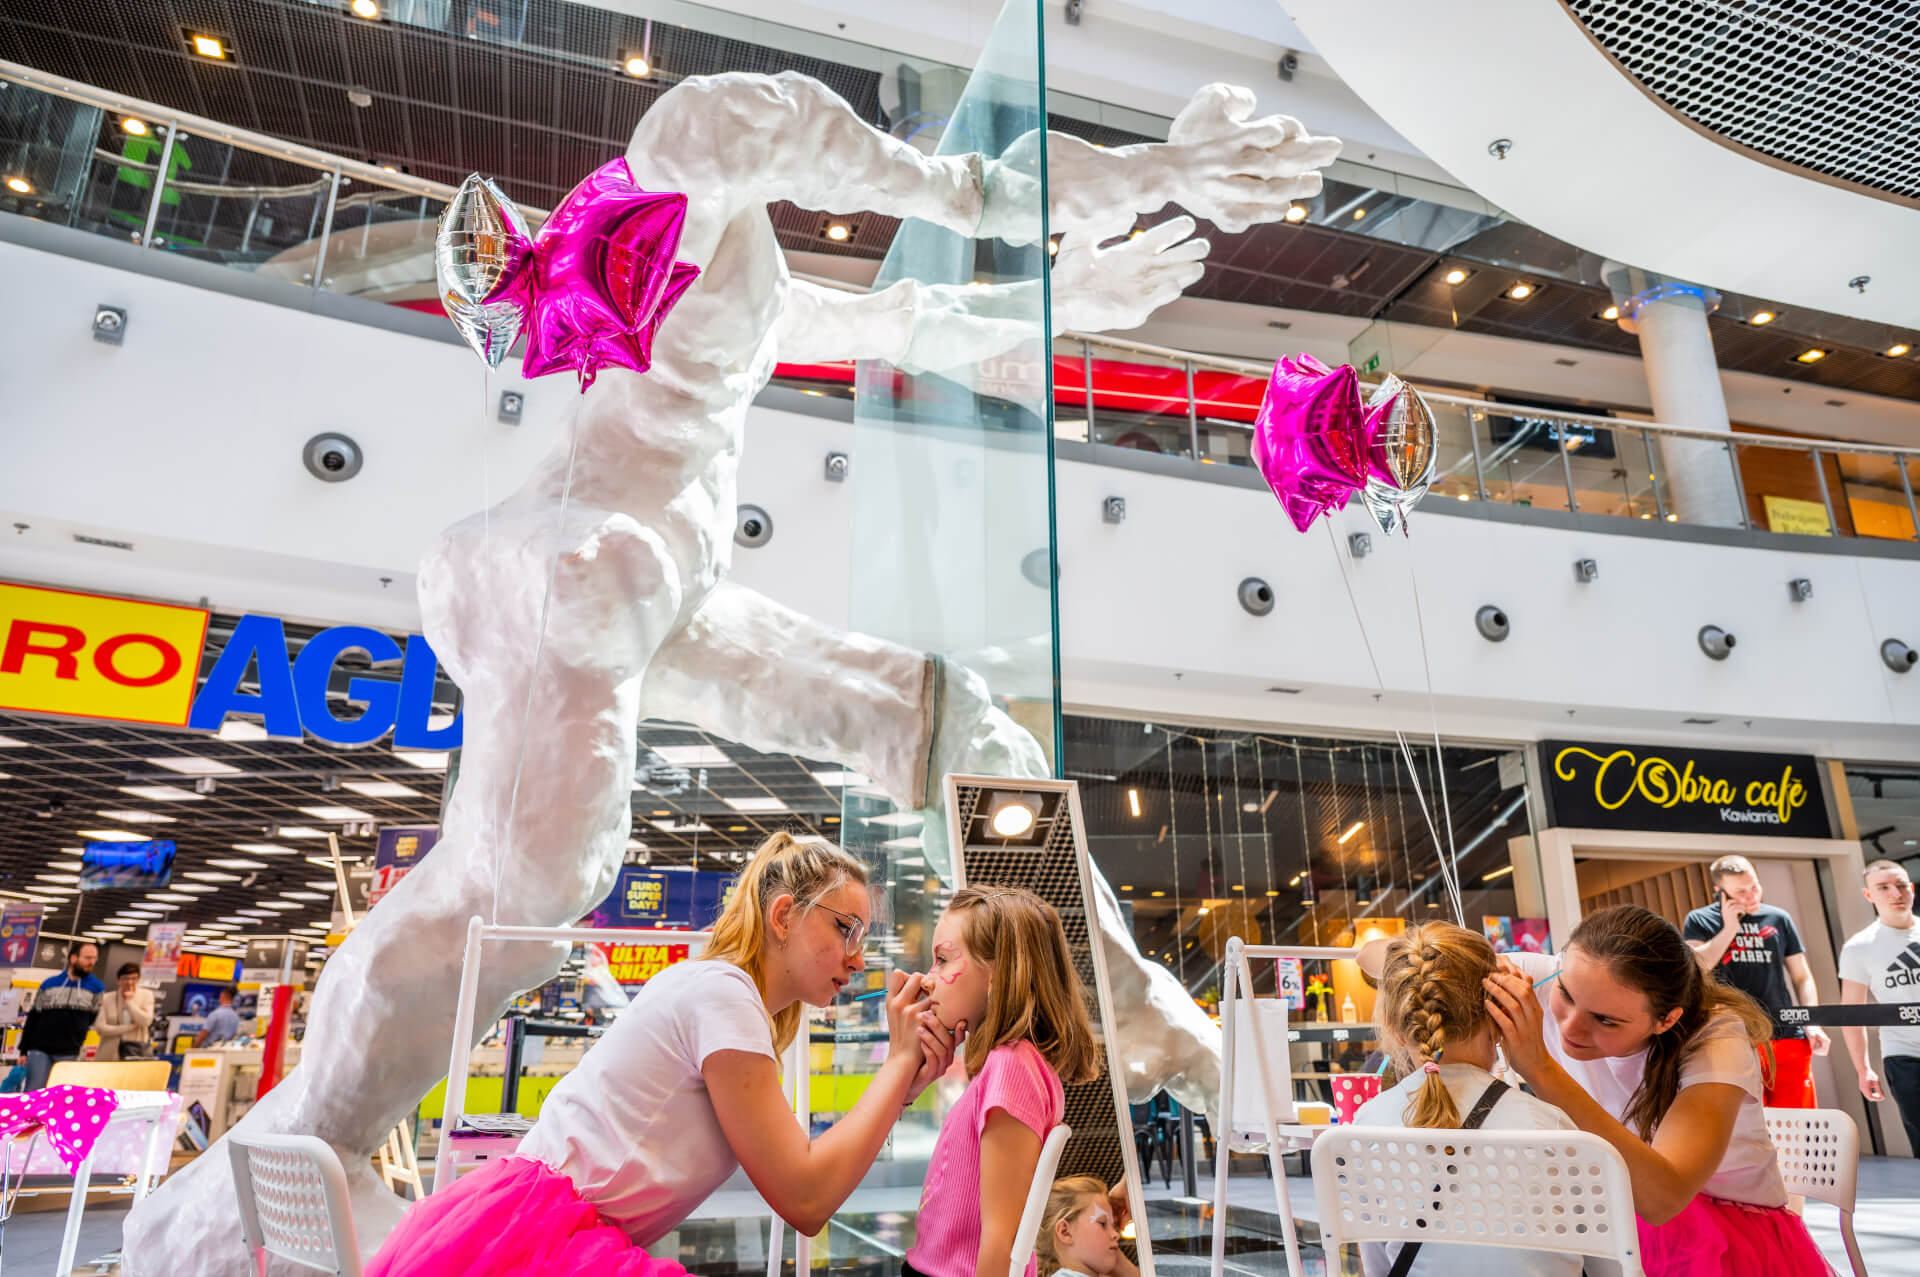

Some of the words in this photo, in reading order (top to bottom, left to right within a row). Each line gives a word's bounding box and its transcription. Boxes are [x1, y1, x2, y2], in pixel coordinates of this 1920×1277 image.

[0, 619, 182, 688] RO
[188, 613, 464, 751] AGD
[631, 881, 662, 891] EURO
[627, 890, 662, 901] SUPER
[629, 901, 658, 911] DAYS
[611, 946, 668, 963] ULTRA
[1731, 950, 1772, 964] CARRY
[1780, 1008, 1810, 1025] agora
